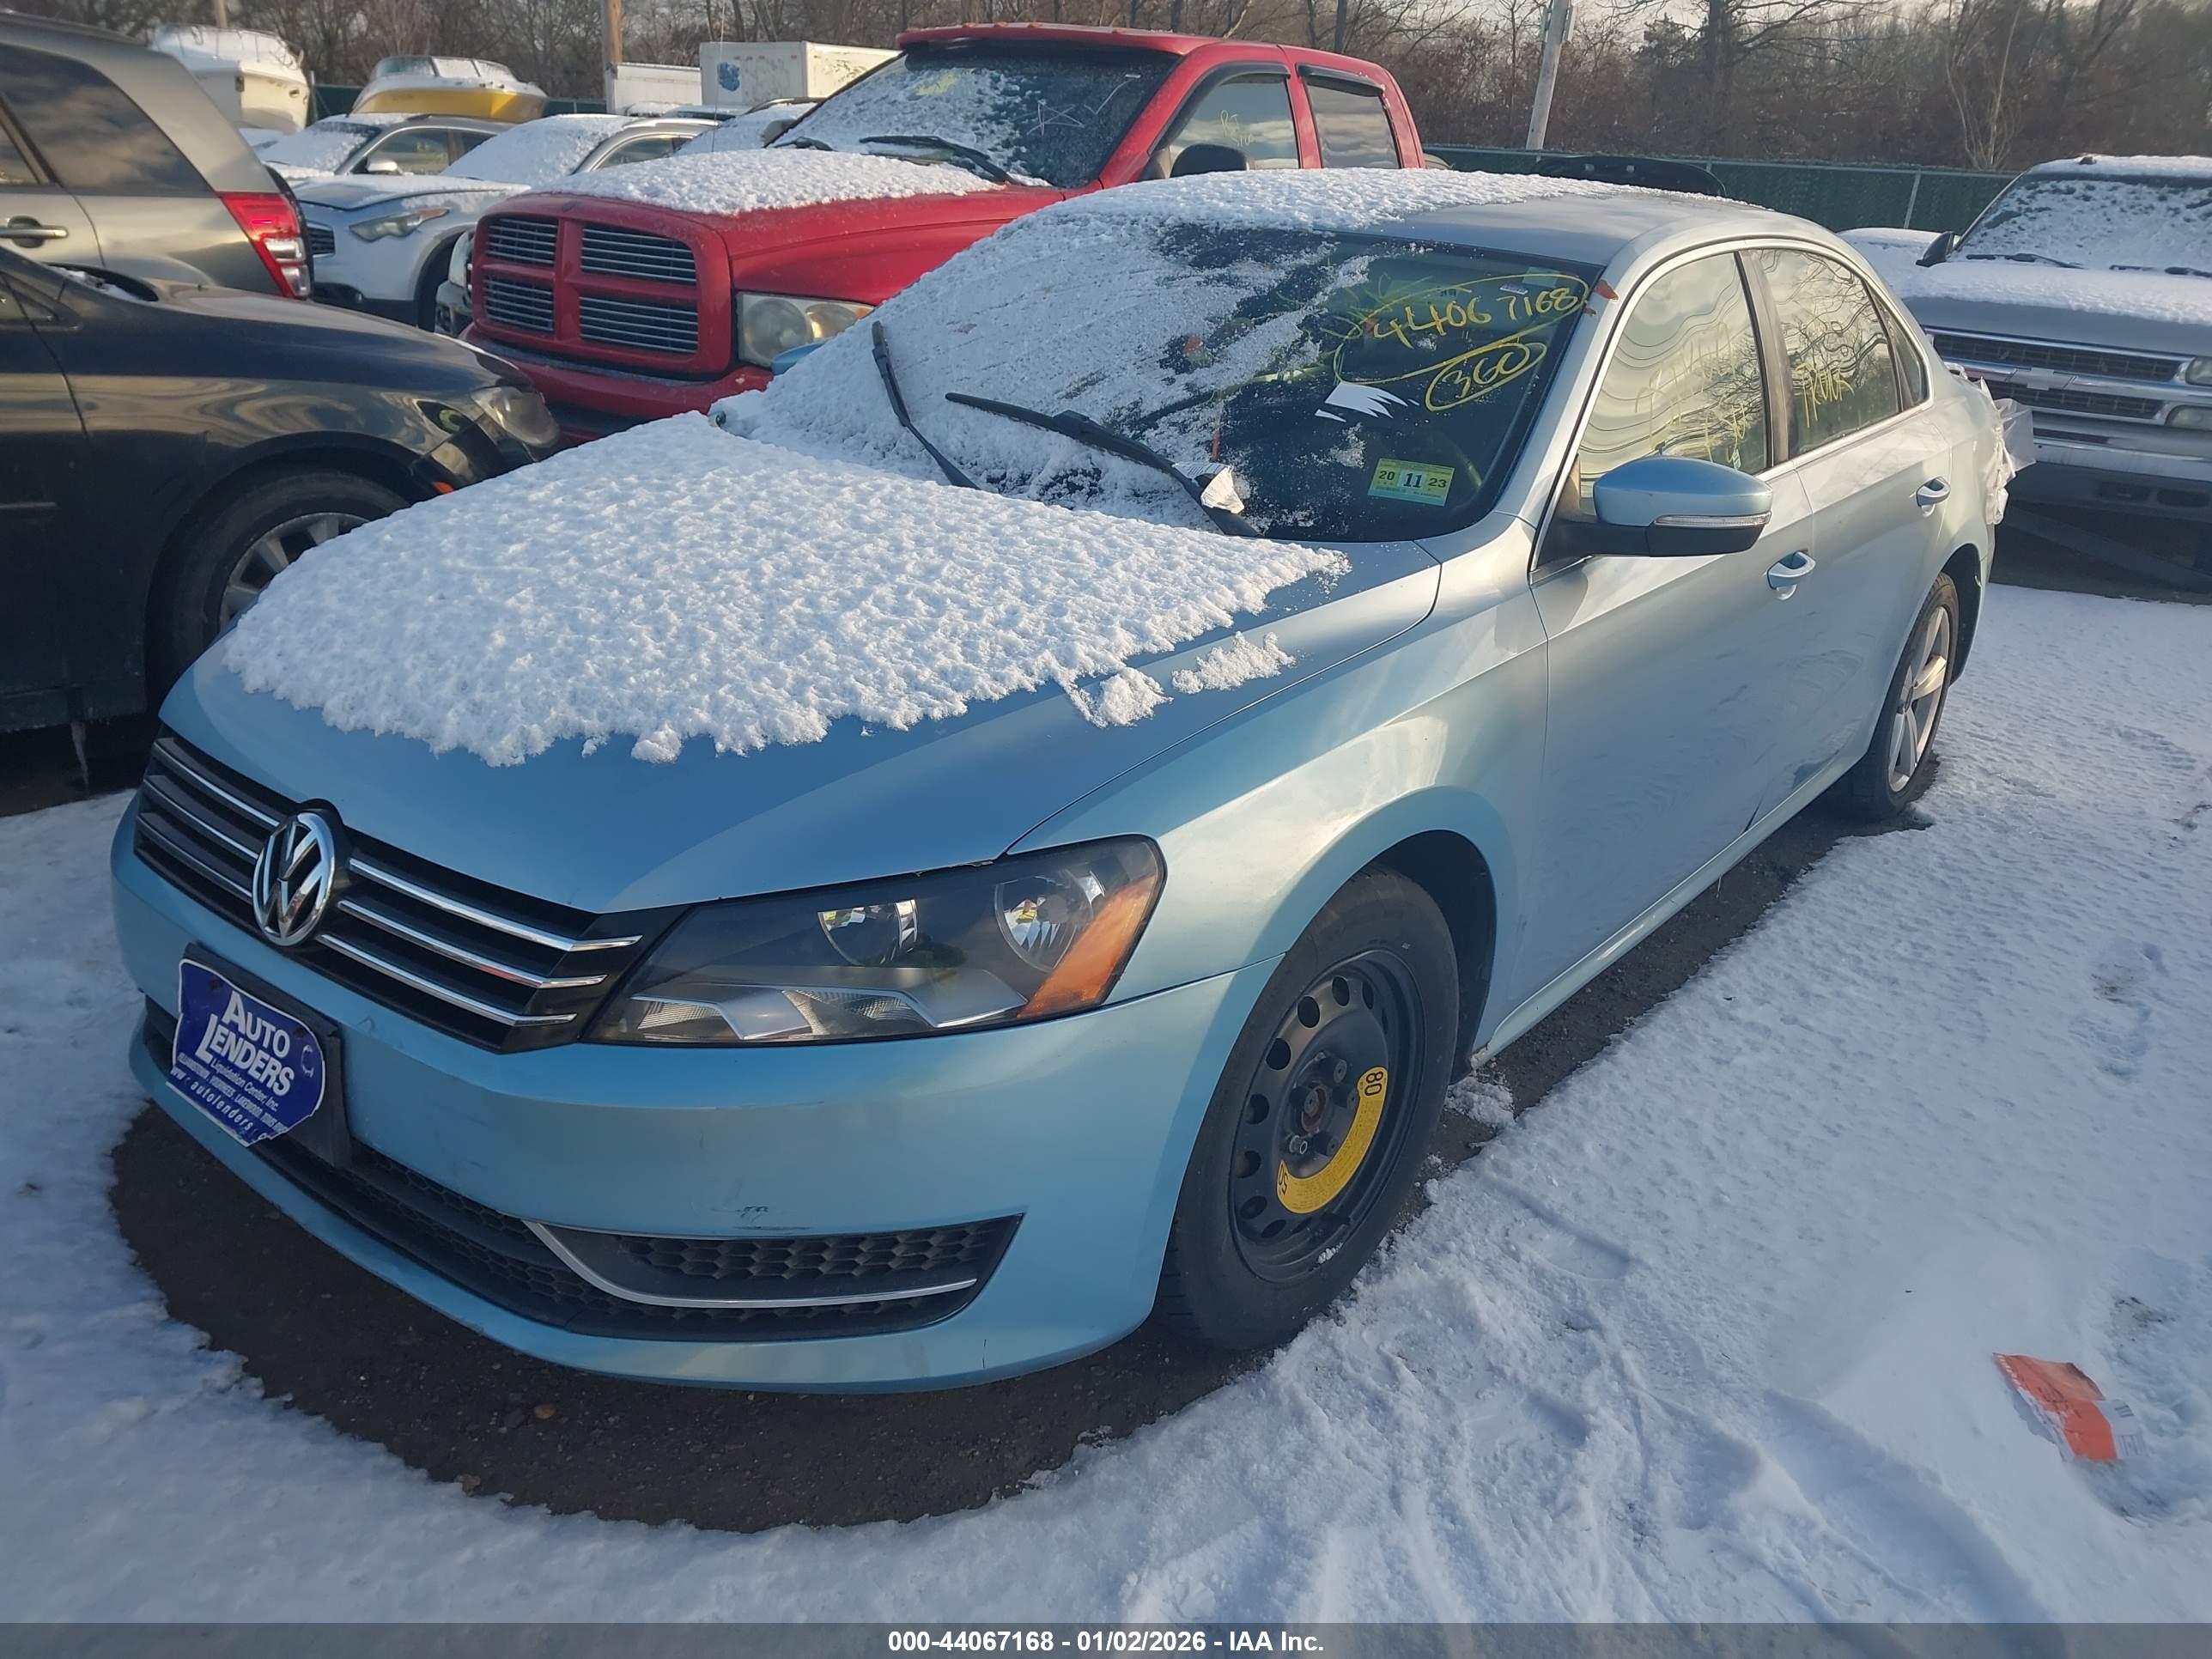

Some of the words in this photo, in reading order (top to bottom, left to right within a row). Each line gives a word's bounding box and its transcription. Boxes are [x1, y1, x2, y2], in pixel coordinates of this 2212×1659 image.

[1442, 352, 1516, 398] 360
[1378, 471, 1395, 481] 20
[1403, 472, 1423, 489] 11
[1428, 477, 1447, 489] 23
[222, 991, 290, 1058] AUTO
[195, 1014, 295, 1097] LENDERS
[1364, 1071, 1383, 1096] 80
